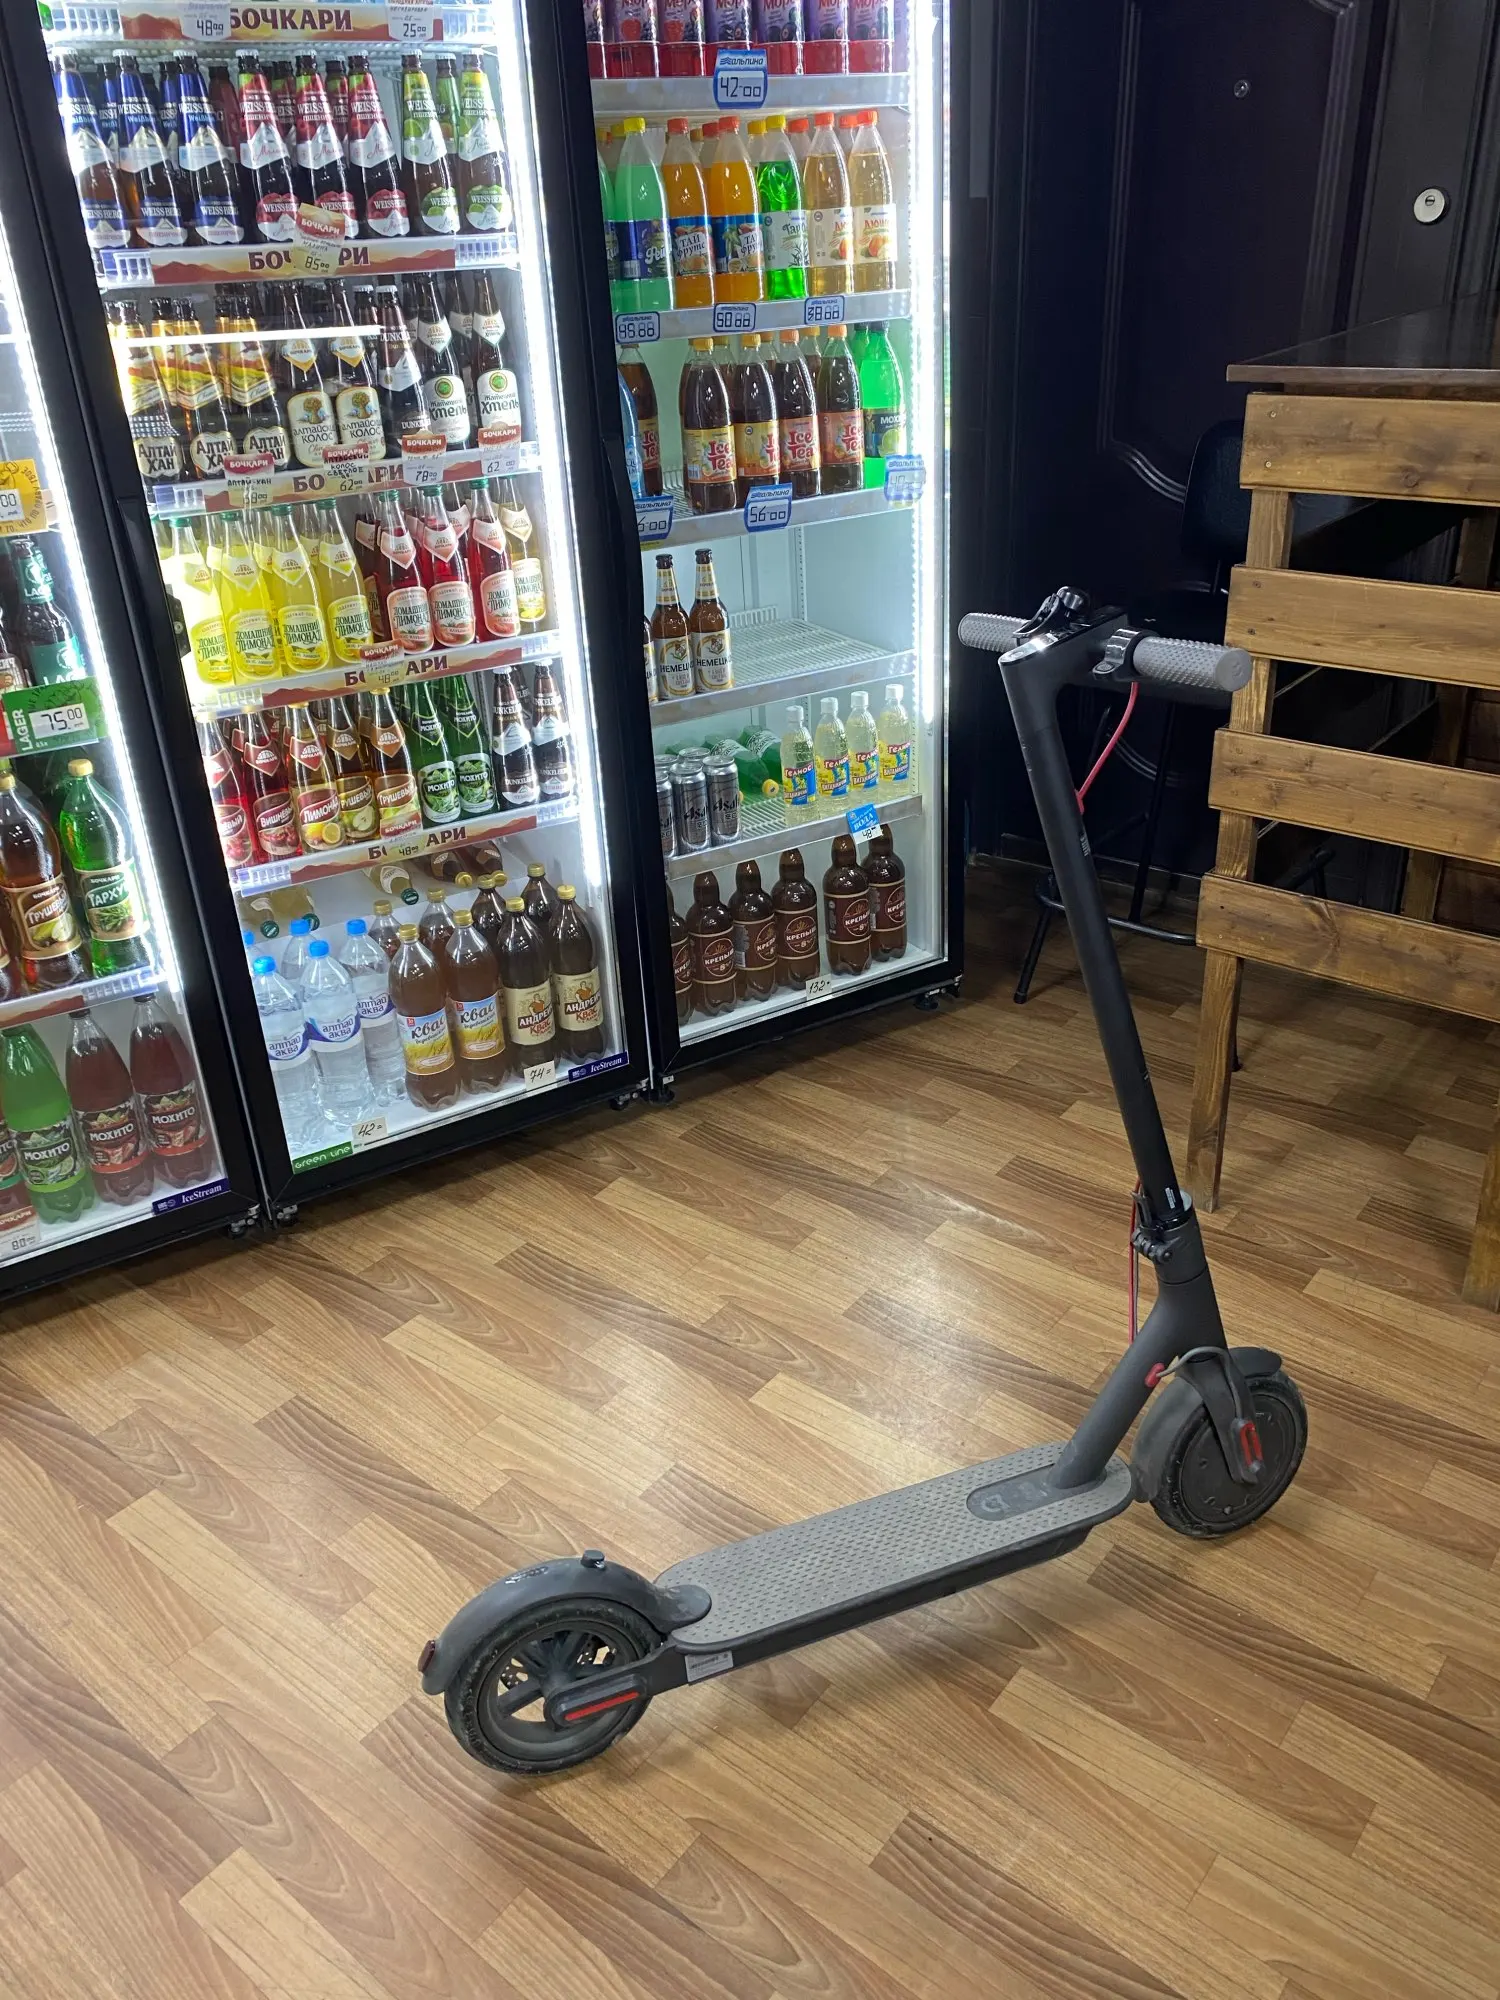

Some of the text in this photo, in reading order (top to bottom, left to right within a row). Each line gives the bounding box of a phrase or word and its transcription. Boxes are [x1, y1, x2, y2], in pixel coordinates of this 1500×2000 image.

[229, 8, 352, 31] БОЧКАРИ
[12, 708, 34, 752] LAGER
[361, 1004, 384, 1015] аква
[328, 1028, 352, 1039] аква
[275, 1044, 299, 1056] аква
[590, 1057, 622, 1074] IceStream
[152, 1106, 196, 1124] МОХИТО
[90, 1123, 134, 1142] МОХИТО
[24, 1142, 70, 1161] МОХИТО
[181, 1185, 222, 1204] IceStream
